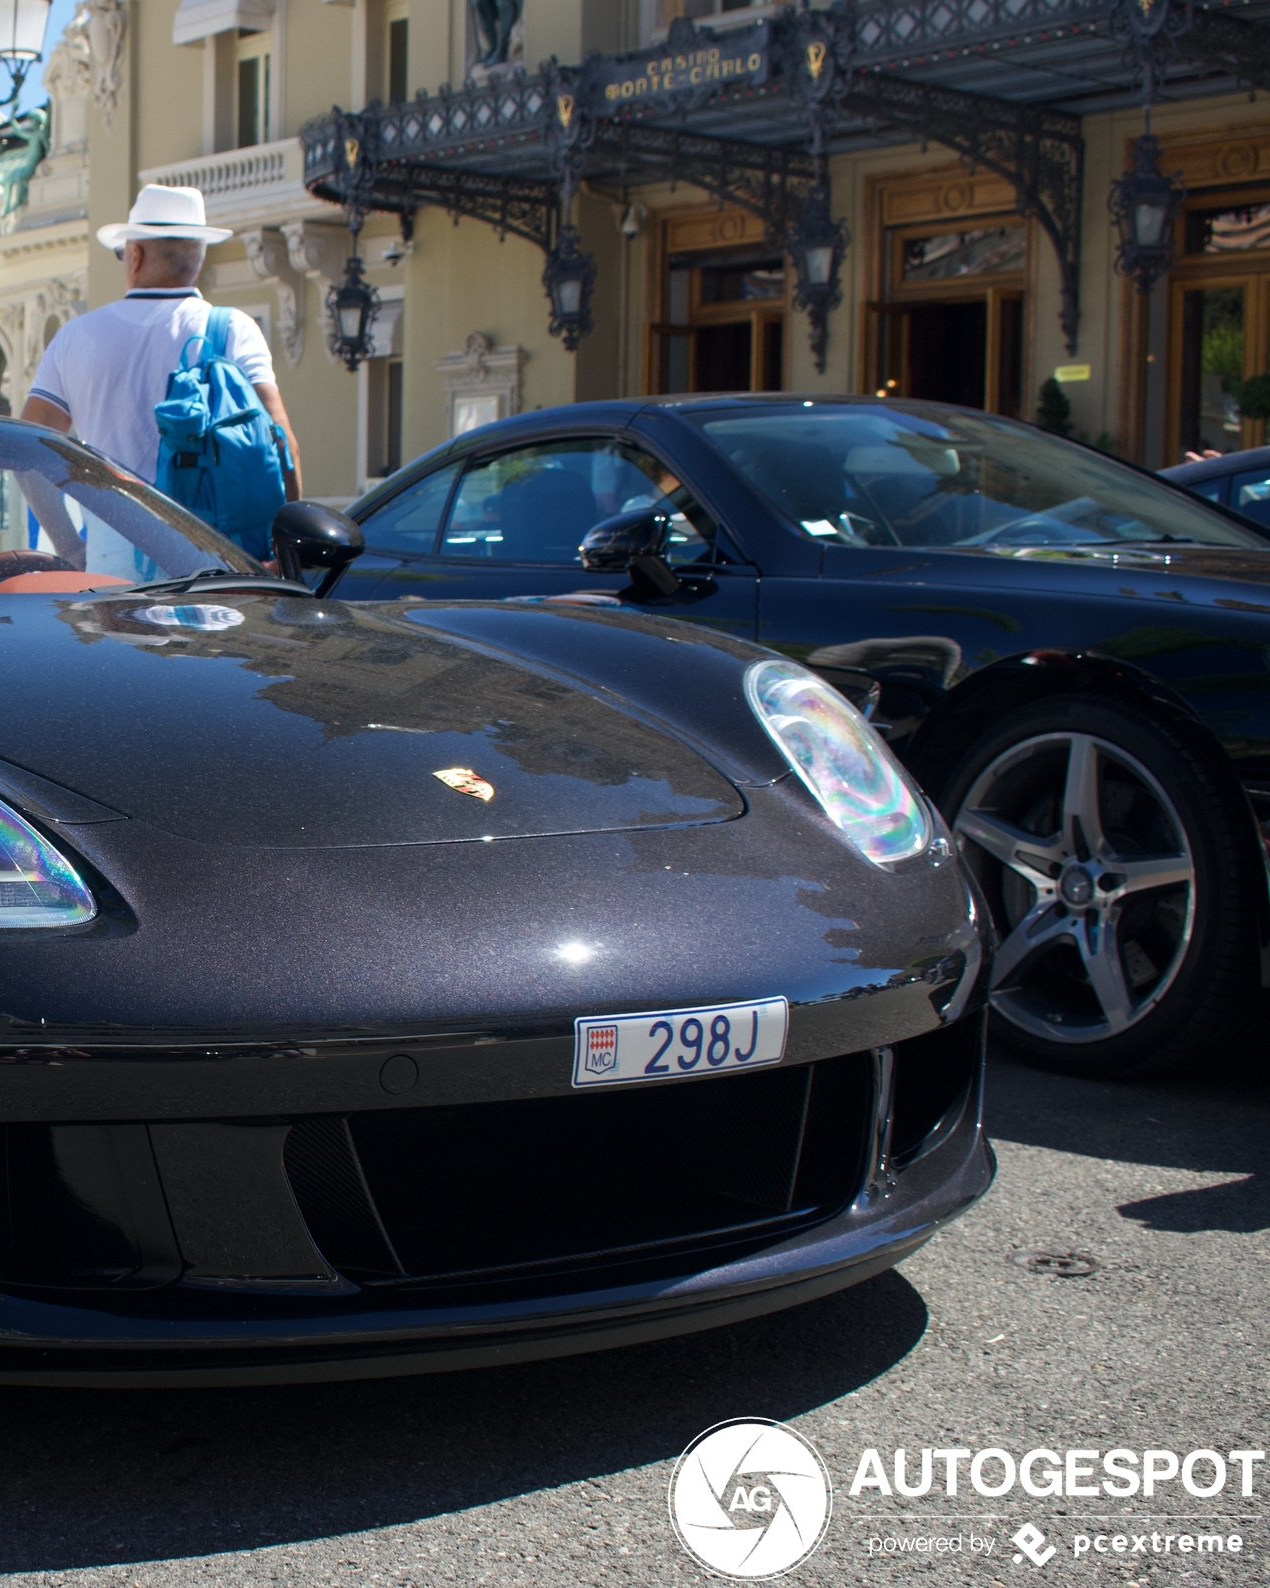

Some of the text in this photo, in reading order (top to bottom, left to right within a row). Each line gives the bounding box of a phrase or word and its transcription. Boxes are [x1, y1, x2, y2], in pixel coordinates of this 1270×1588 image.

[605, 53, 761, 100] MONTE-CARLO
[647, 48, 720, 76] CASINO
[591, 1052, 612, 1067] MC
[644, 1010, 758, 1074] 298J
